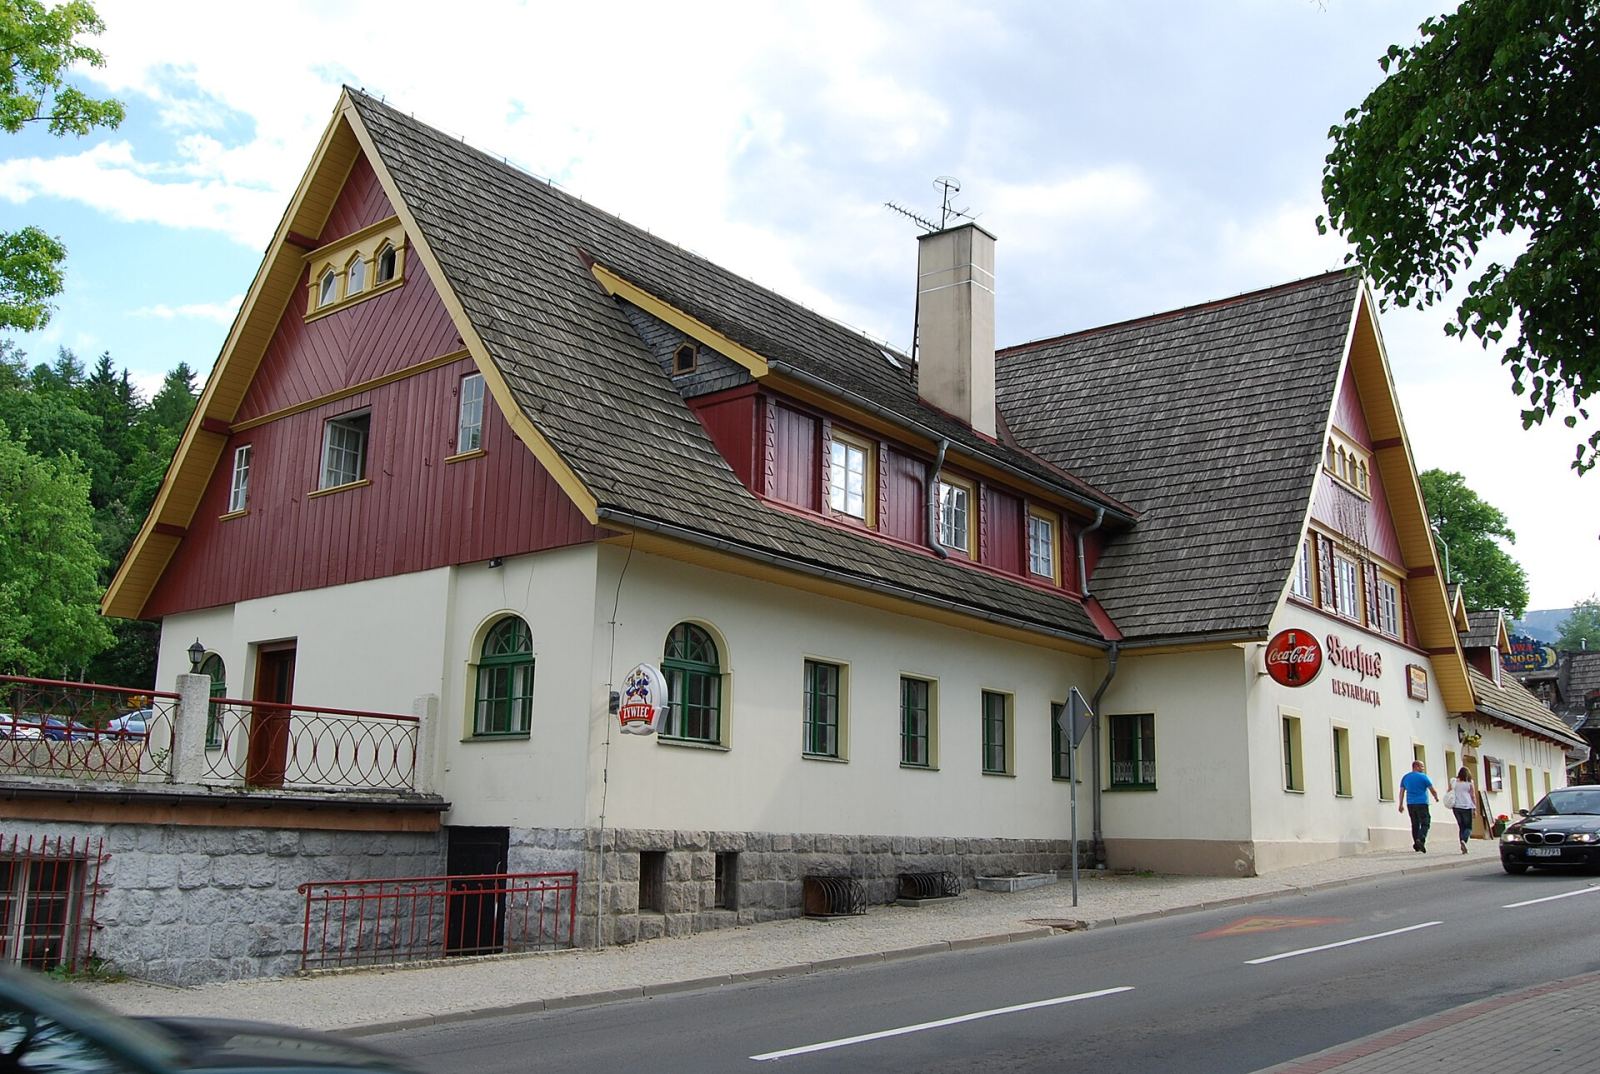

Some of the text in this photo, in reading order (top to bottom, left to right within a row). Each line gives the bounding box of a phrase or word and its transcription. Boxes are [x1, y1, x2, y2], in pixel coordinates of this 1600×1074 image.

[1326, 634, 1382, 682] Bachus
[1332, 679, 1381, 708] RESTAURACJA
[623, 705, 650, 719] ŻYWIEC
